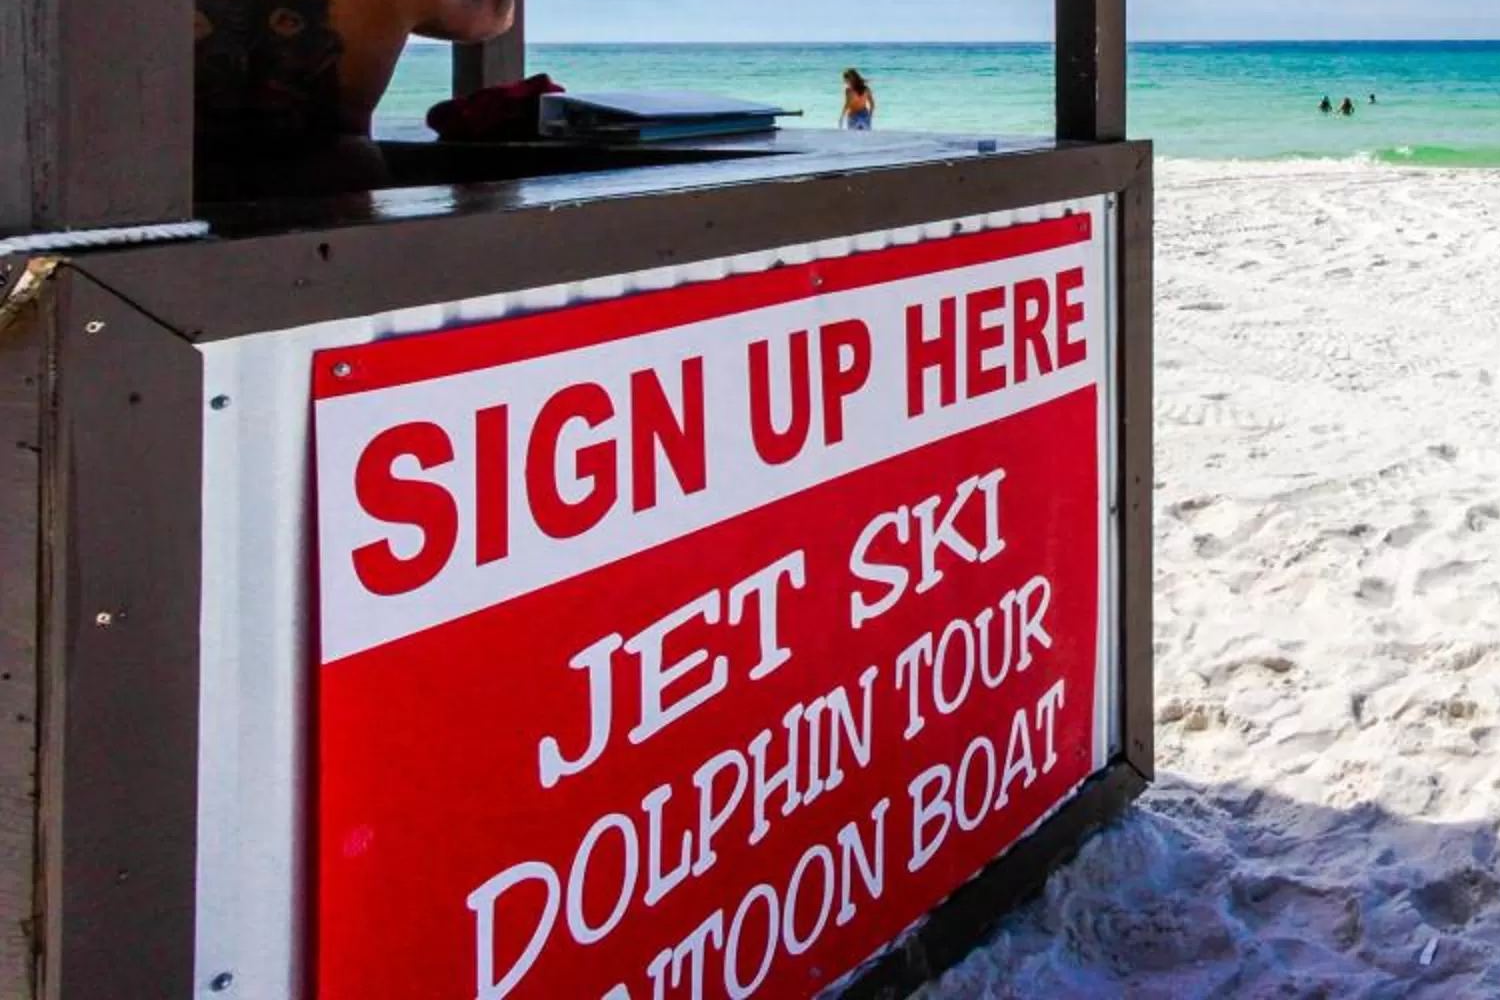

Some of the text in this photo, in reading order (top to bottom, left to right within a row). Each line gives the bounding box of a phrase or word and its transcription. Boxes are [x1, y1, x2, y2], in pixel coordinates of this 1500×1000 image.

[351, 267, 1088, 596] SIGN UP HERE
[466, 575, 1052, 1000] DOLPHIN TOUR
[539, 469, 1006, 788] JET SKI
[907, 680, 1065, 872] BOAT
